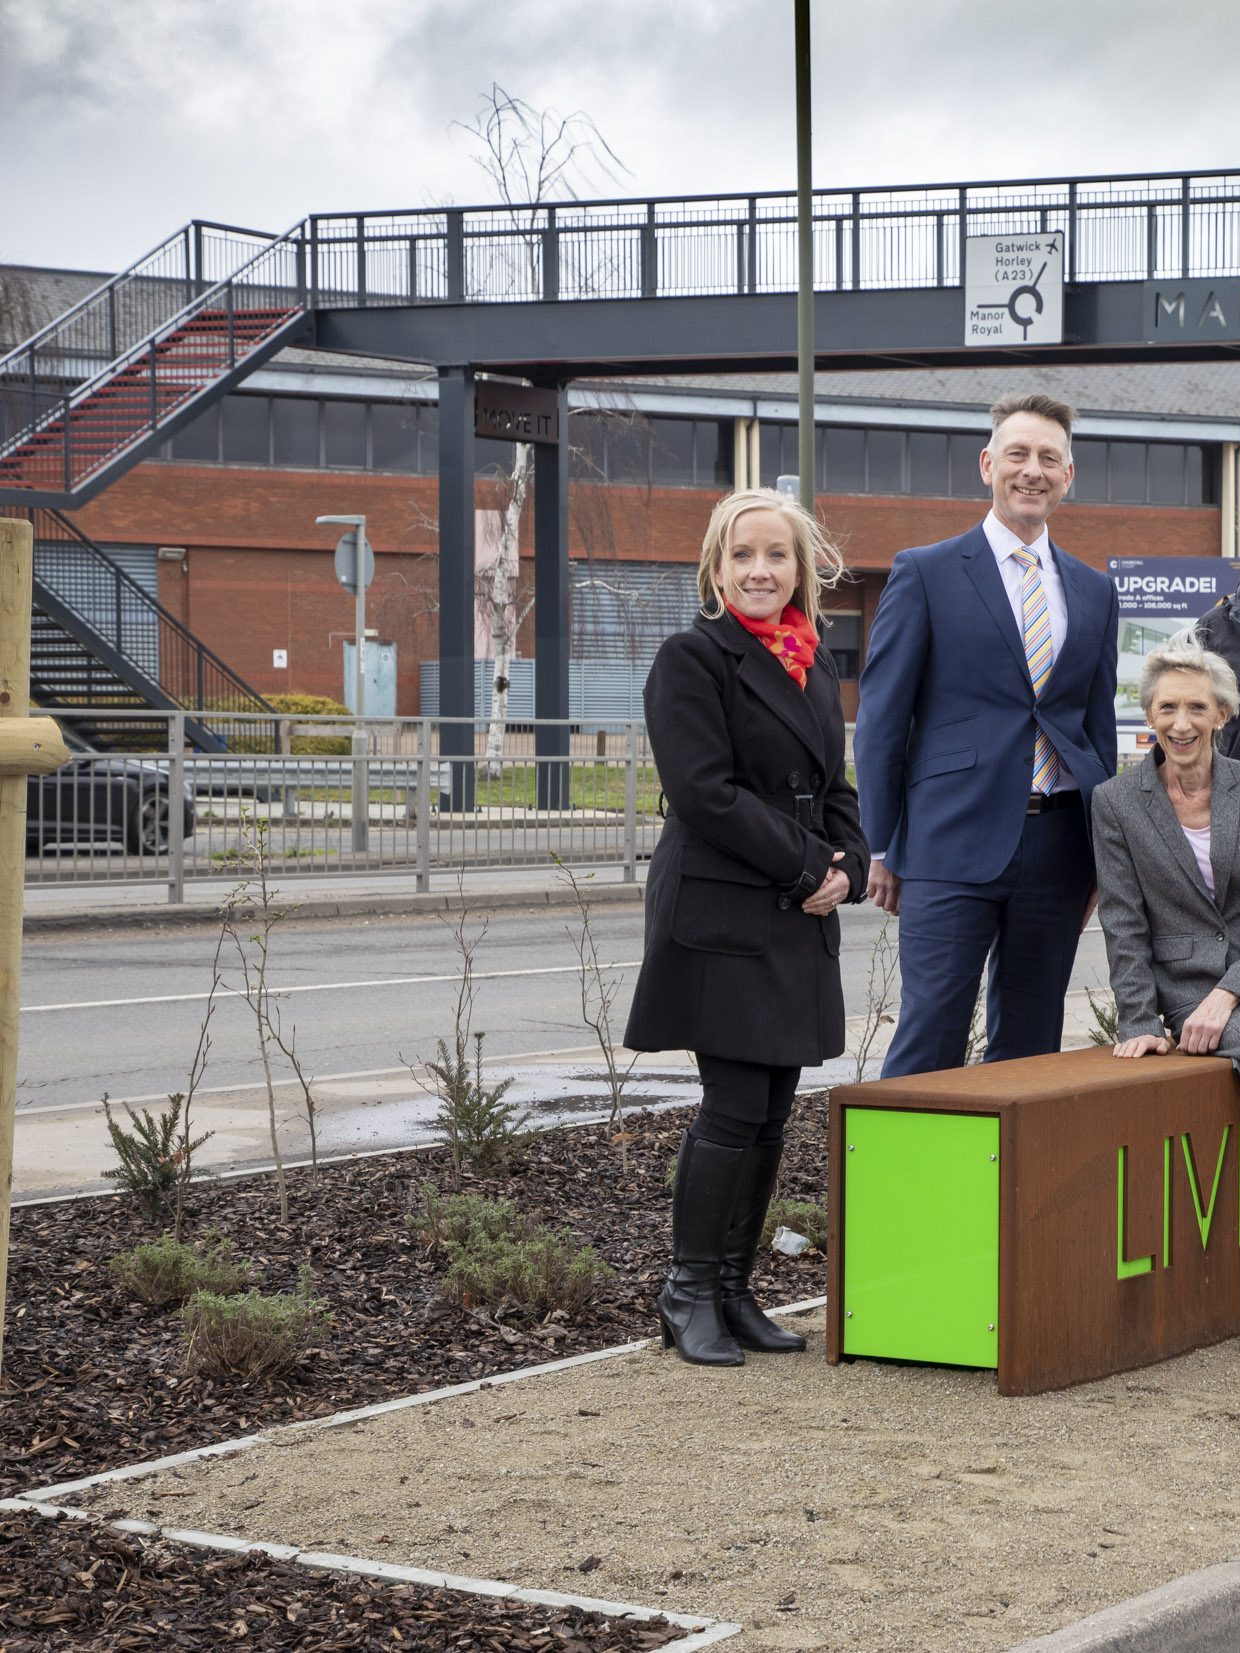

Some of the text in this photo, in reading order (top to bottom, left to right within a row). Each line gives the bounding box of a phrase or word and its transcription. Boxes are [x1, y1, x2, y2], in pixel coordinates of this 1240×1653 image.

[994, 241, 1042, 253] Gatwick
[994, 256, 1033, 268] Horley
[994, 268, 1034, 282] (A23)
[970, 310, 1005, 321] Manor
[971, 324, 1003, 336] Royal
[483, 407, 552, 436] MOVE IT
[1114, 576, 1217, 593] UPGRADE!
[1172, 603, 1181, 611] sq
